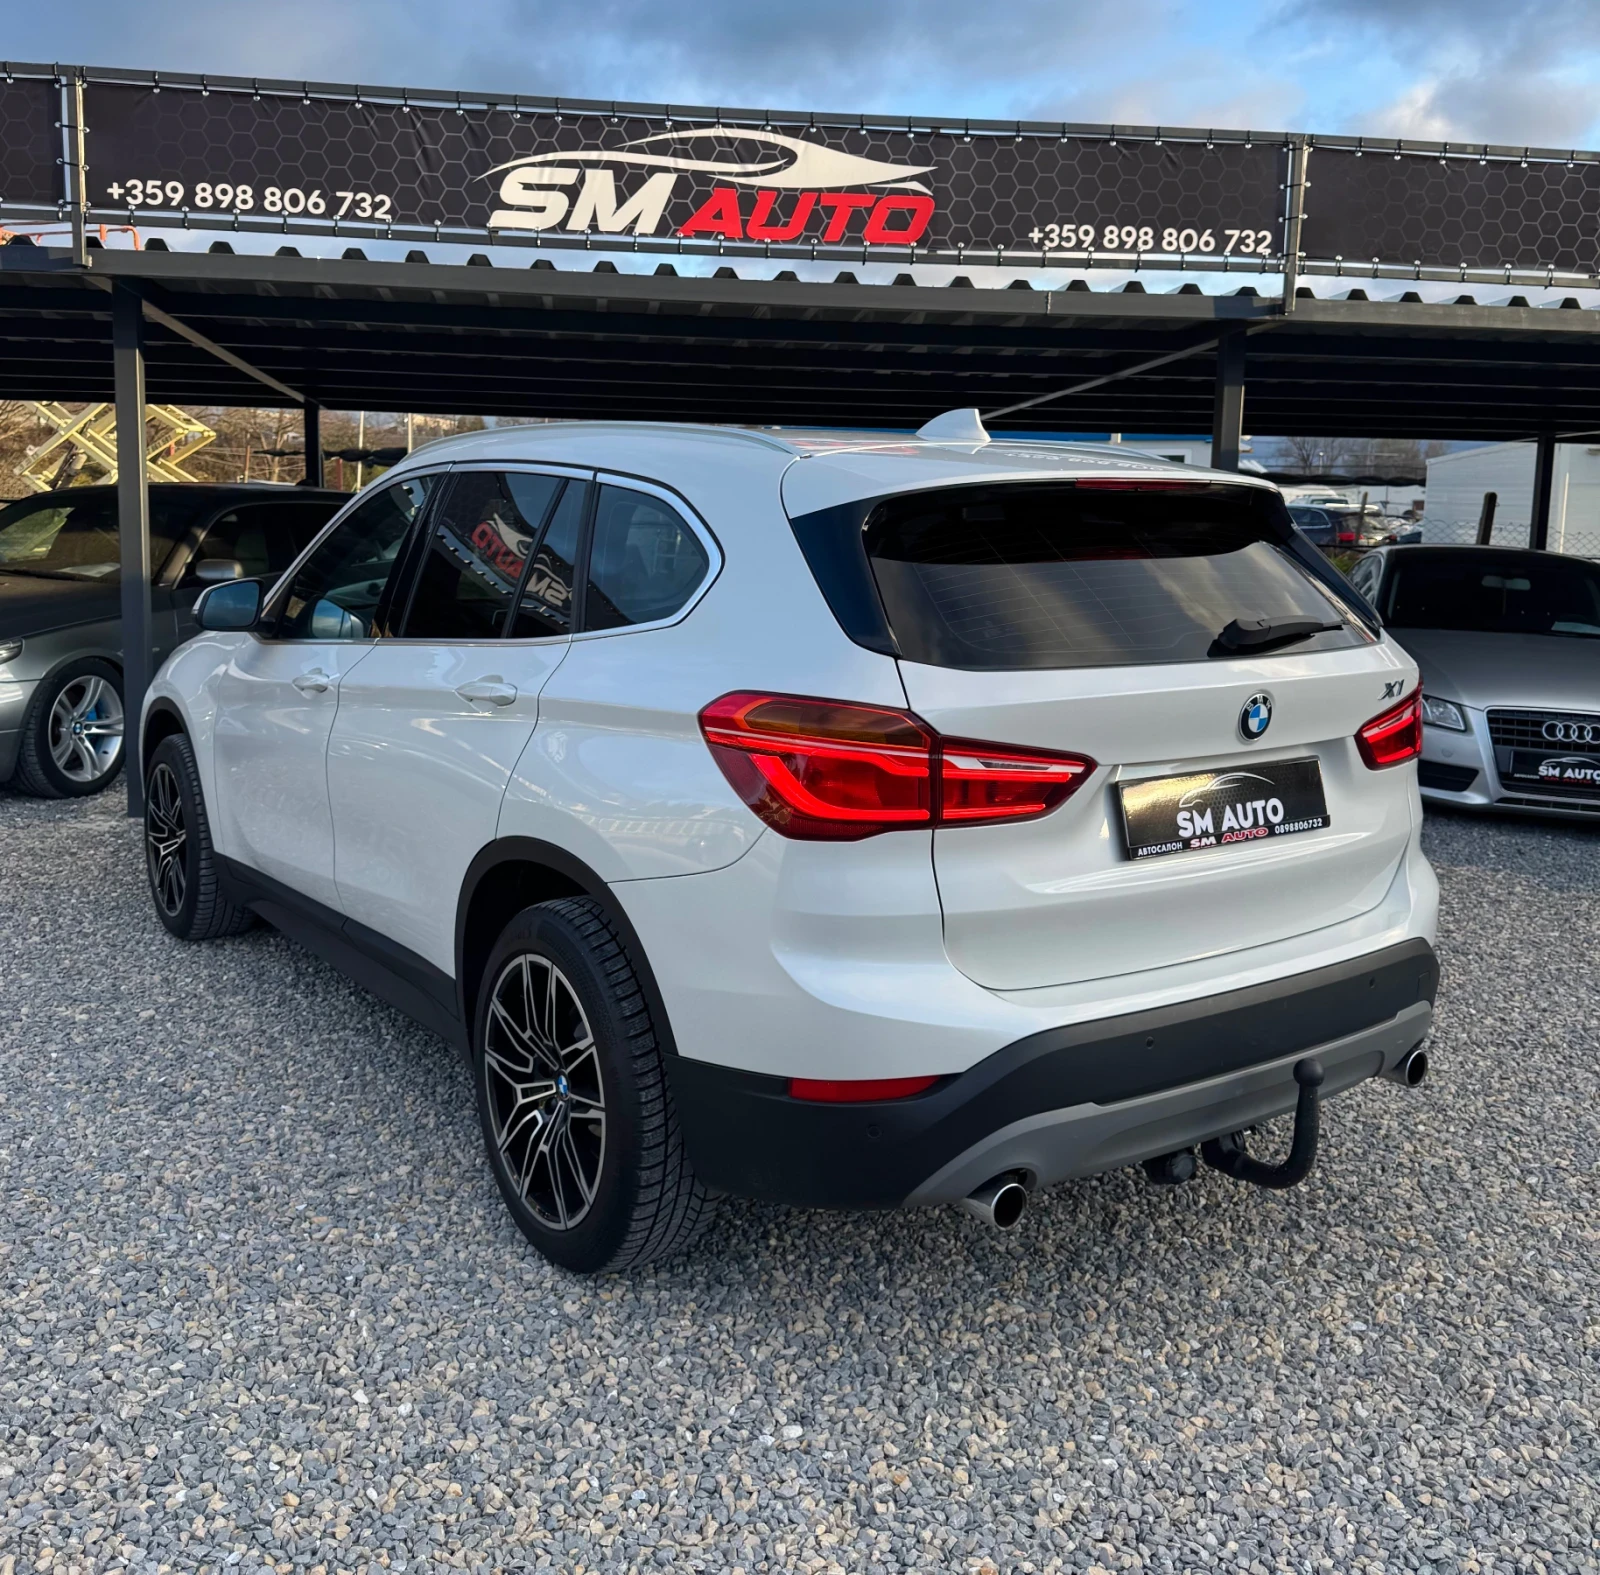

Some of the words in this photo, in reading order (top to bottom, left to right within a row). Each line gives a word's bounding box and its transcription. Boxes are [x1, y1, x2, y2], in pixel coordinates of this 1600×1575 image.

[107, 179, 184, 206] +359
[195, 183, 254, 210] 898
[264, 186, 326, 214] 806
[335, 191, 392, 220] 732
[490, 167, 678, 233] SM
[674, 188, 936, 243] AUTO
[1028, 224, 1095, 249] +359
[1103, 225, 1154, 251] 898
[1161, 228, 1216, 253] 806
[1224, 229, 1273, 255] 732
[1377, 679, 1405, 701] X1
[1539, 765, 1561, 777] SM
[1176, 807, 1214, 838] SM
[1221, 797, 1285, 831] AUTO
[1137, 840, 1183, 857] АВТОСАЛОН
[1189, 835, 1217, 849] SM
[1221, 827, 1269, 844] AUTO
[1274, 818, 1323, 835] 0898806732
